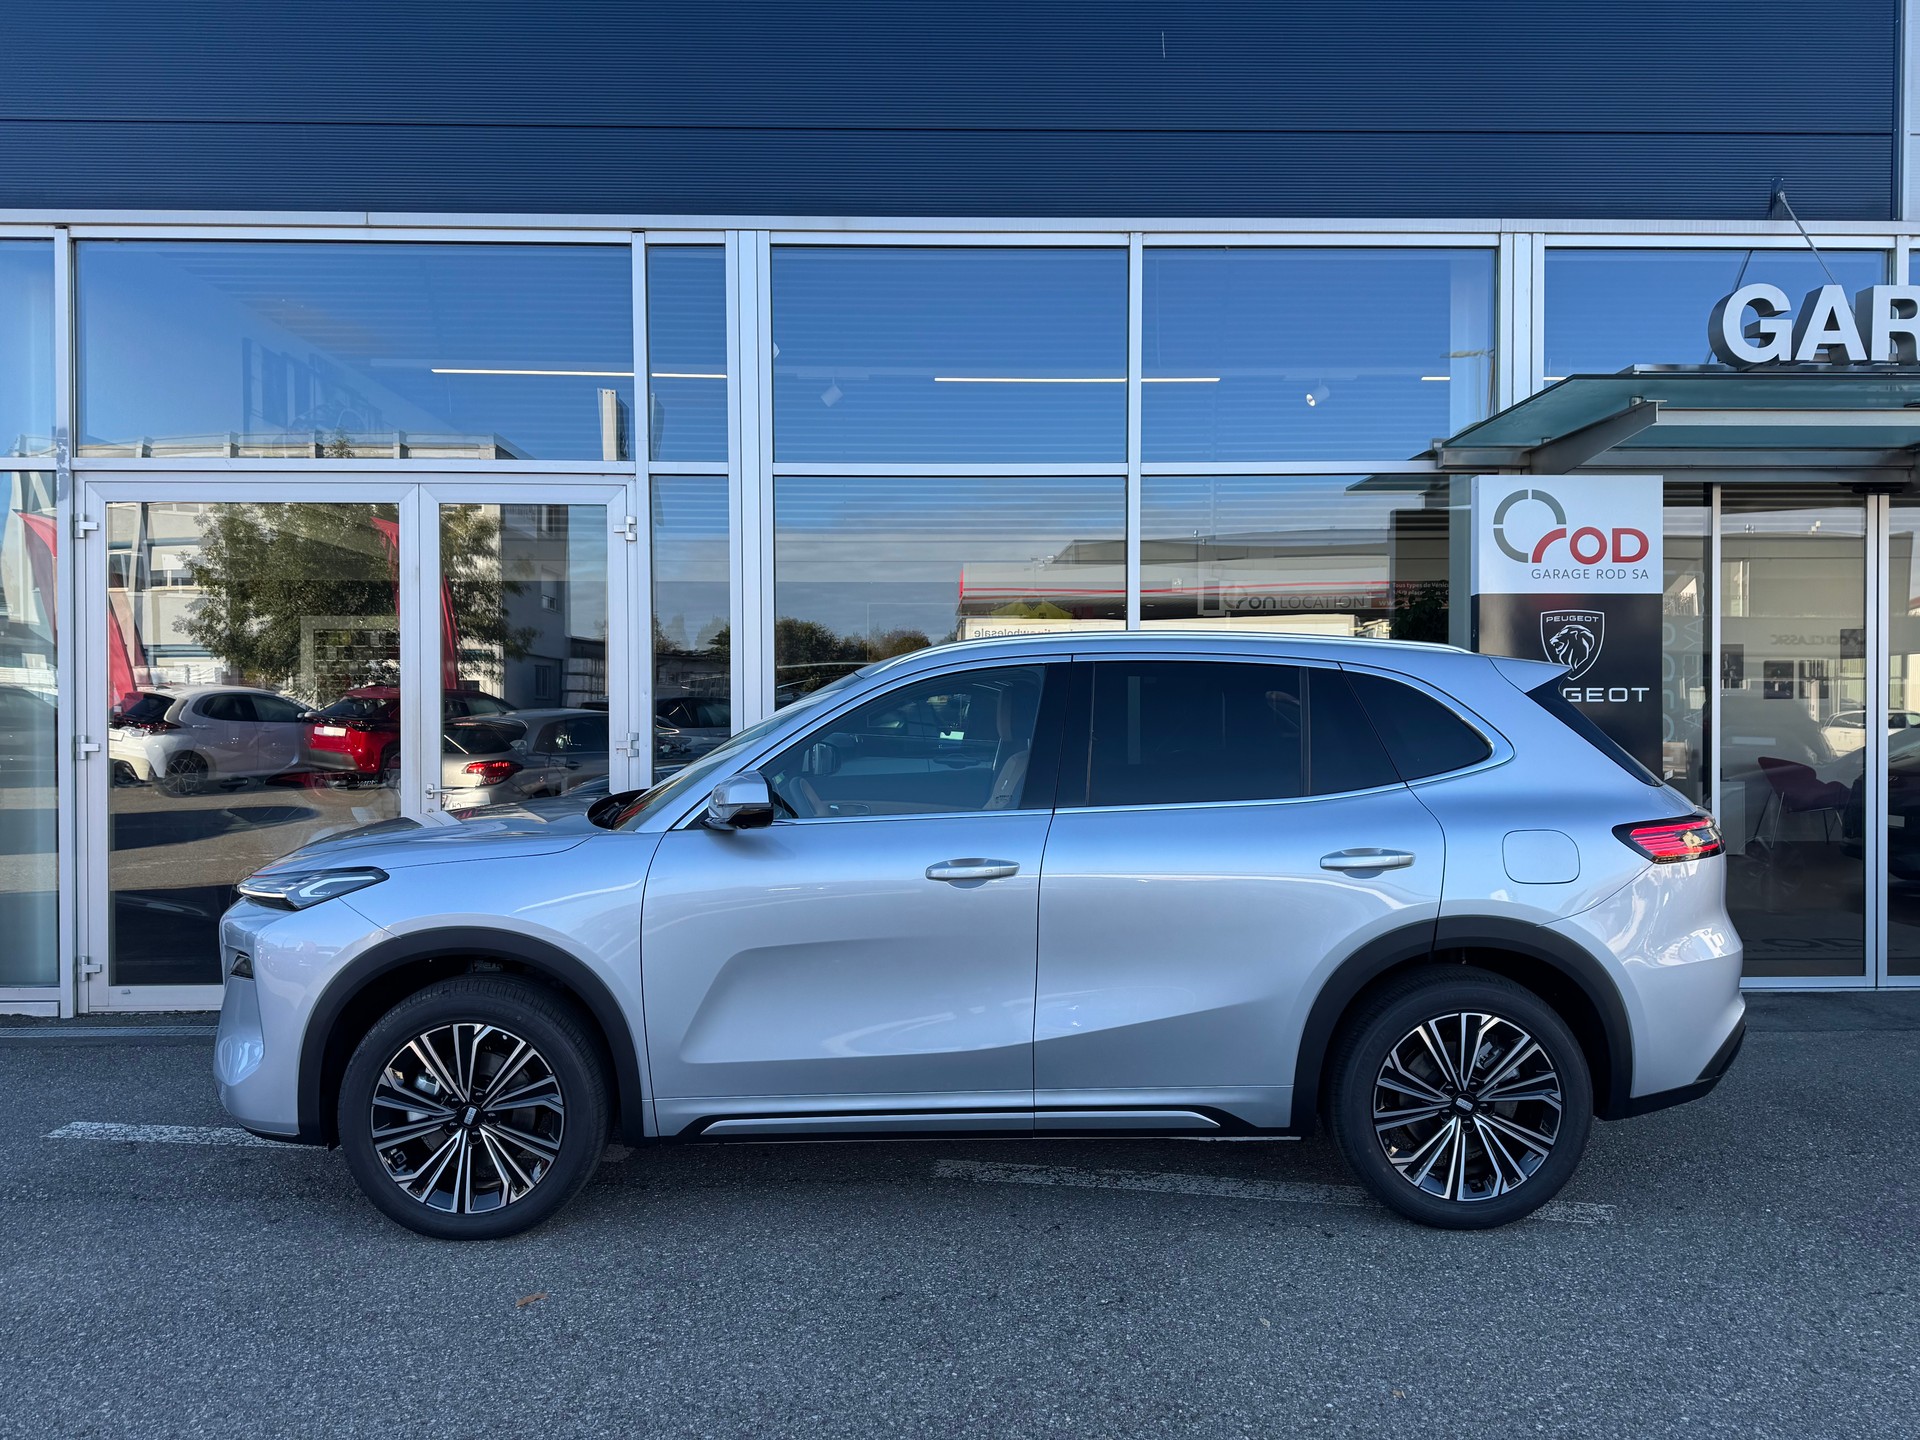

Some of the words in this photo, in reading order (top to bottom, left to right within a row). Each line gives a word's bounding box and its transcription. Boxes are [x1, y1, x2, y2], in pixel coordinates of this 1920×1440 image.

[1714, 283, 1920, 364] GAR
[1531, 568, 1590, 579] GARAGE
[1596, 568, 1627, 579] ROD
[1632, 568, 1649, 579] SA
[1280, 596, 1365, 609] LOCATION
[1545, 615, 1600, 623] PEUGEOT
